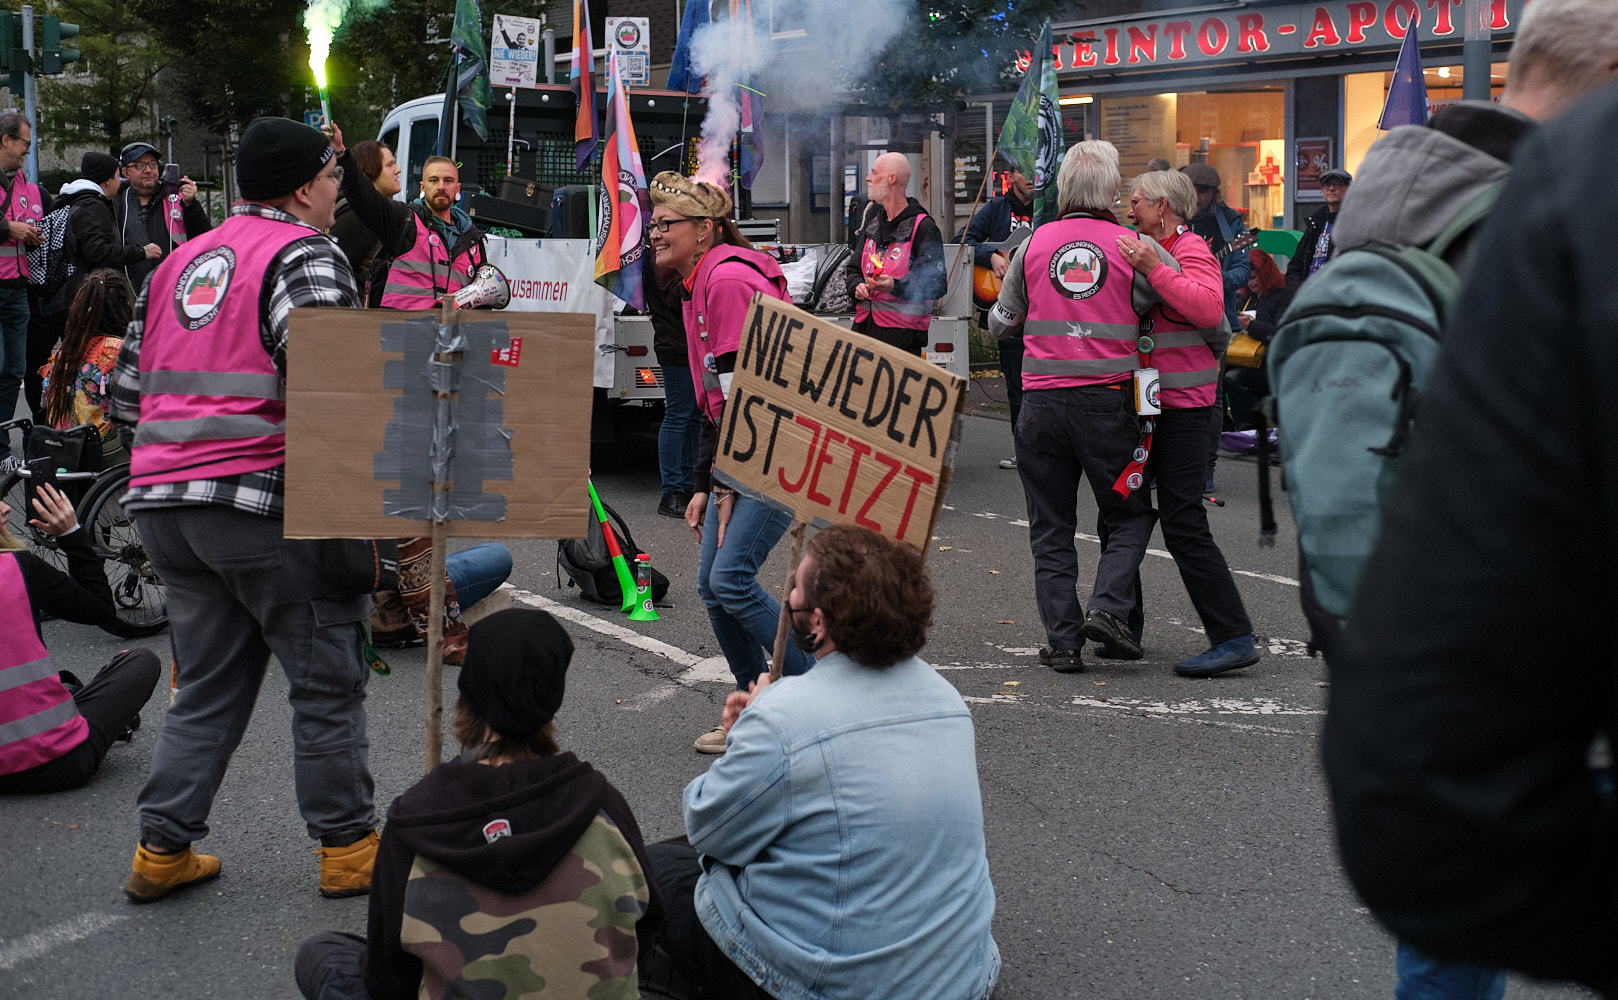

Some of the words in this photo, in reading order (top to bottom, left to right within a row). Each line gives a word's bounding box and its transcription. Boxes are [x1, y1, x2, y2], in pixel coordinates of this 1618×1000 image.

[493, 49, 506, 60] NIE
[1049, 252, 1060, 279] BÜNDNIS
[1058, 241, 1105, 259] RECKLINGHAUSEN
[723, 388, 794, 476] IST
[778, 415, 935, 541] JETZT
